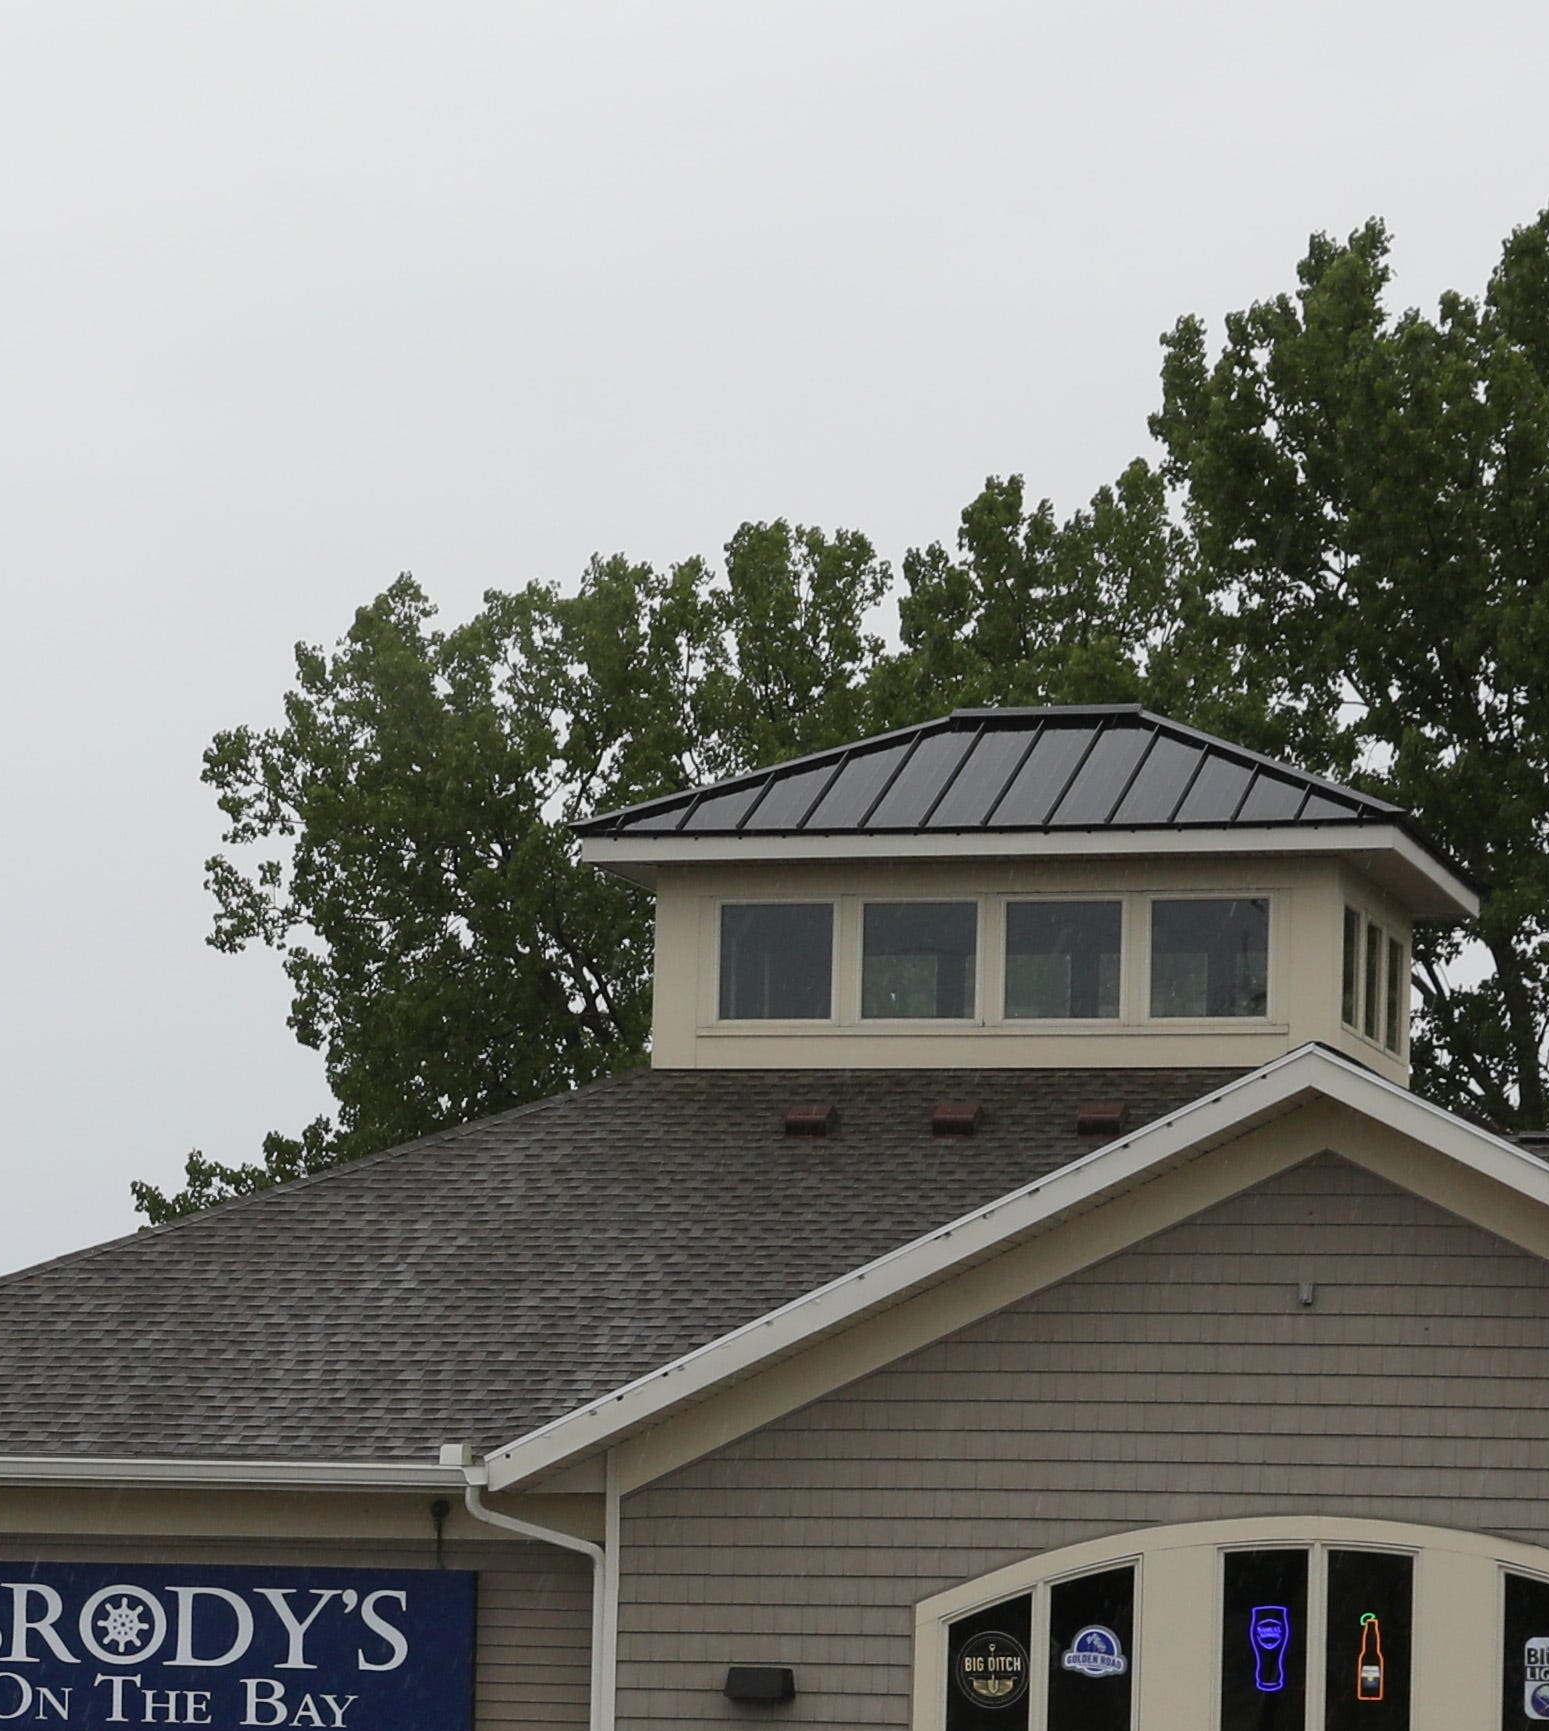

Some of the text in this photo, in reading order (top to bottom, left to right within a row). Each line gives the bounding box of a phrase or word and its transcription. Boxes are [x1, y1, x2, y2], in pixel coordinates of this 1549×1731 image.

[964, 1656, 1021, 1672] BIG DITCH
[1067, 1654, 1121, 1669] GOLDEN ROAD
